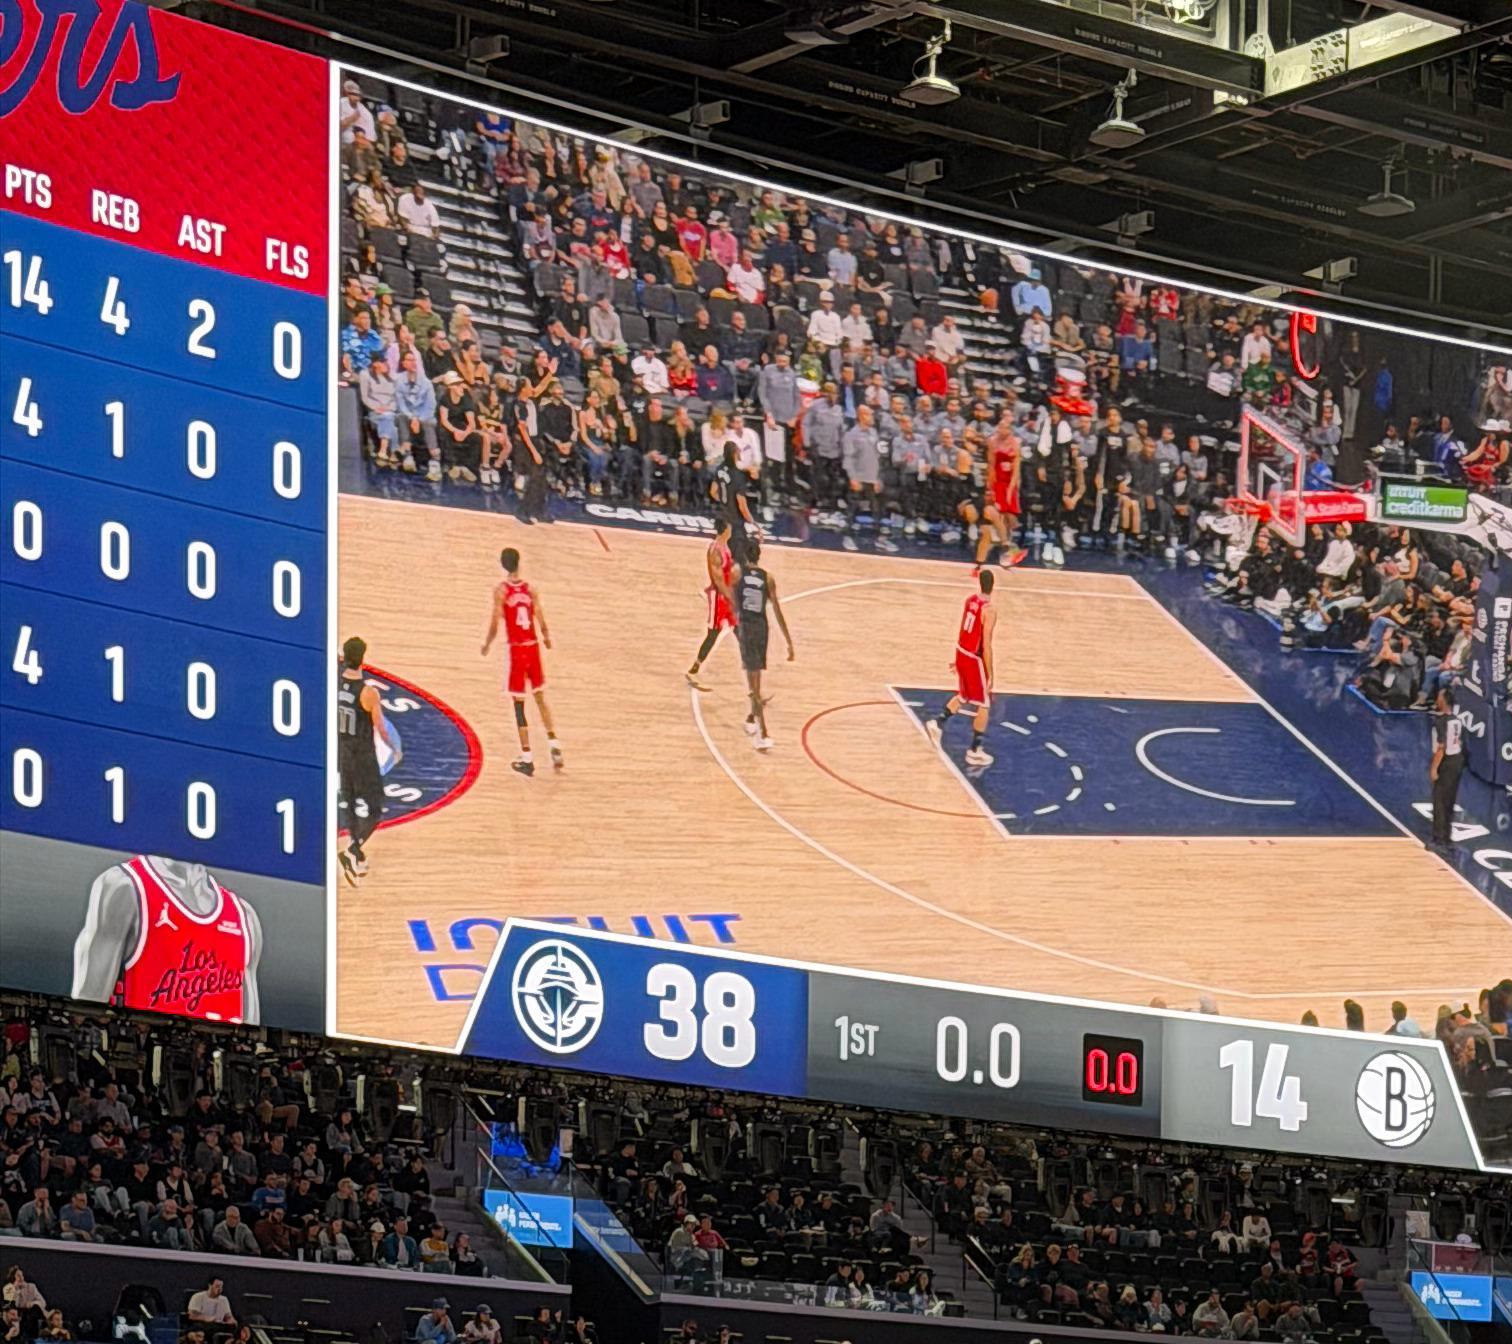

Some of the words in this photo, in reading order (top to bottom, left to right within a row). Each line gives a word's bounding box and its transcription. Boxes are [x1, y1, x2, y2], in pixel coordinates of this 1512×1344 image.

[5, 164, 52, 208] PTS
[92, 189, 140, 233] REB
[178, 215, 226, 257] AST
[266, 238, 309, 279] FLS
[4, 250, 53, 315] 14
[100, 276, 130, 336] 4
[188, 299, 216, 359] 2
[273, 322, 301, 379] 0
[13, 377, 42, 437] 4
[105, 401, 124, 458] 1
[187, 421, 216, 479] 0
[273, 441, 301, 499] 0
[13, 626, 42, 684] 4
[105, 645, 124, 702] 1
[105, 766, 124, 824] 1
[276, 799, 294, 854] 1
[151, 961, 242, 1012] Angeles
[180, 940, 217, 973] Los
[644, 962, 755, 1068] 38
[834, 1015, 879, 1060] 1ST
[936, 1016, 1021, 1089] 0.0
[1085, 1049, 1137, 1095] 0.0
[1218, 1040, 1307, 1132] 14
